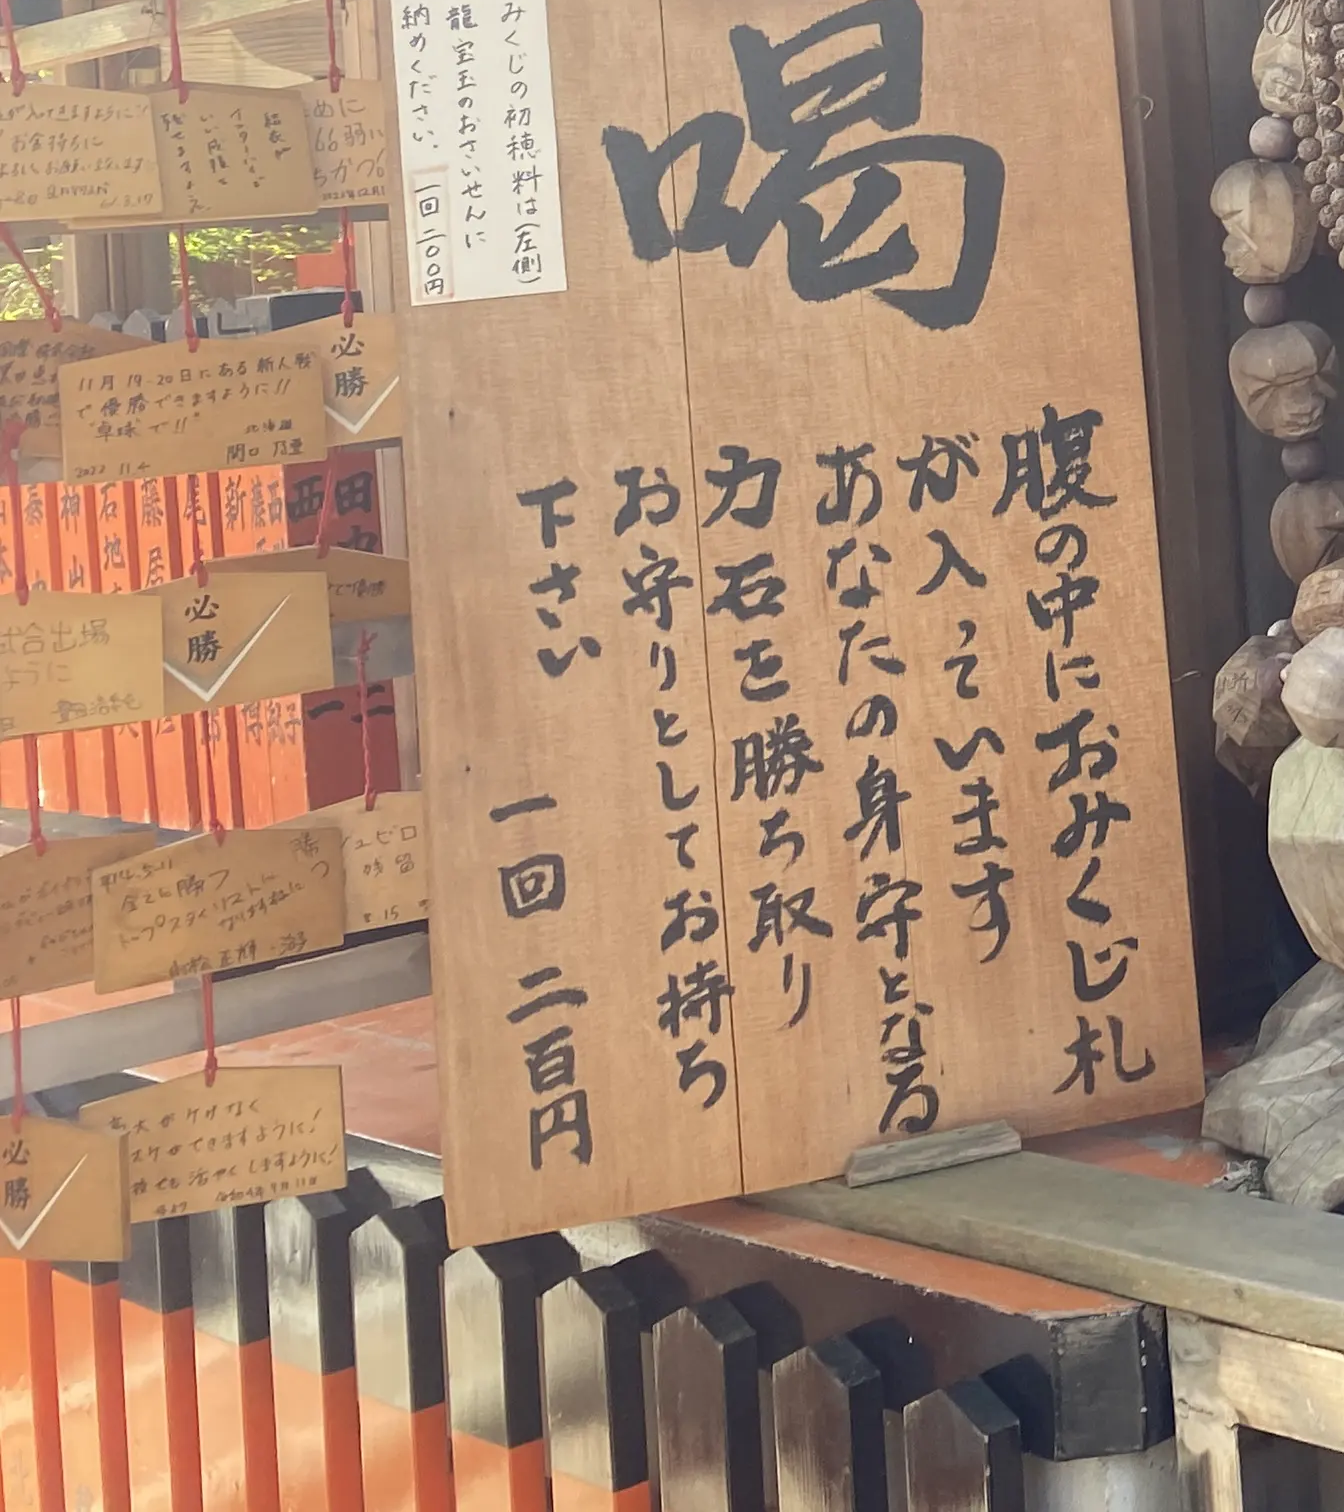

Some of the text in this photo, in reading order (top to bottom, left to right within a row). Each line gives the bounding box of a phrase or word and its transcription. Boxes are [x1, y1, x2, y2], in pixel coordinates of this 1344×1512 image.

[184, 592, 224, 663] 必勝
[330, 333, 370, 400] 必勝
[516, 478, 604, 679] 下さい
[612, 464, 735, 1113] お守りとしてお持ち
[702, 443, 836, 1032] 力石を勝ち取り
[814, 440, 946, 1135] あなたの身守となる
[897, 425, 1018, 966] が入っています
[994, 402, 1156, 1100] 腹の中におみくじ札
[2, 1138, 32, 1211] 必勝
